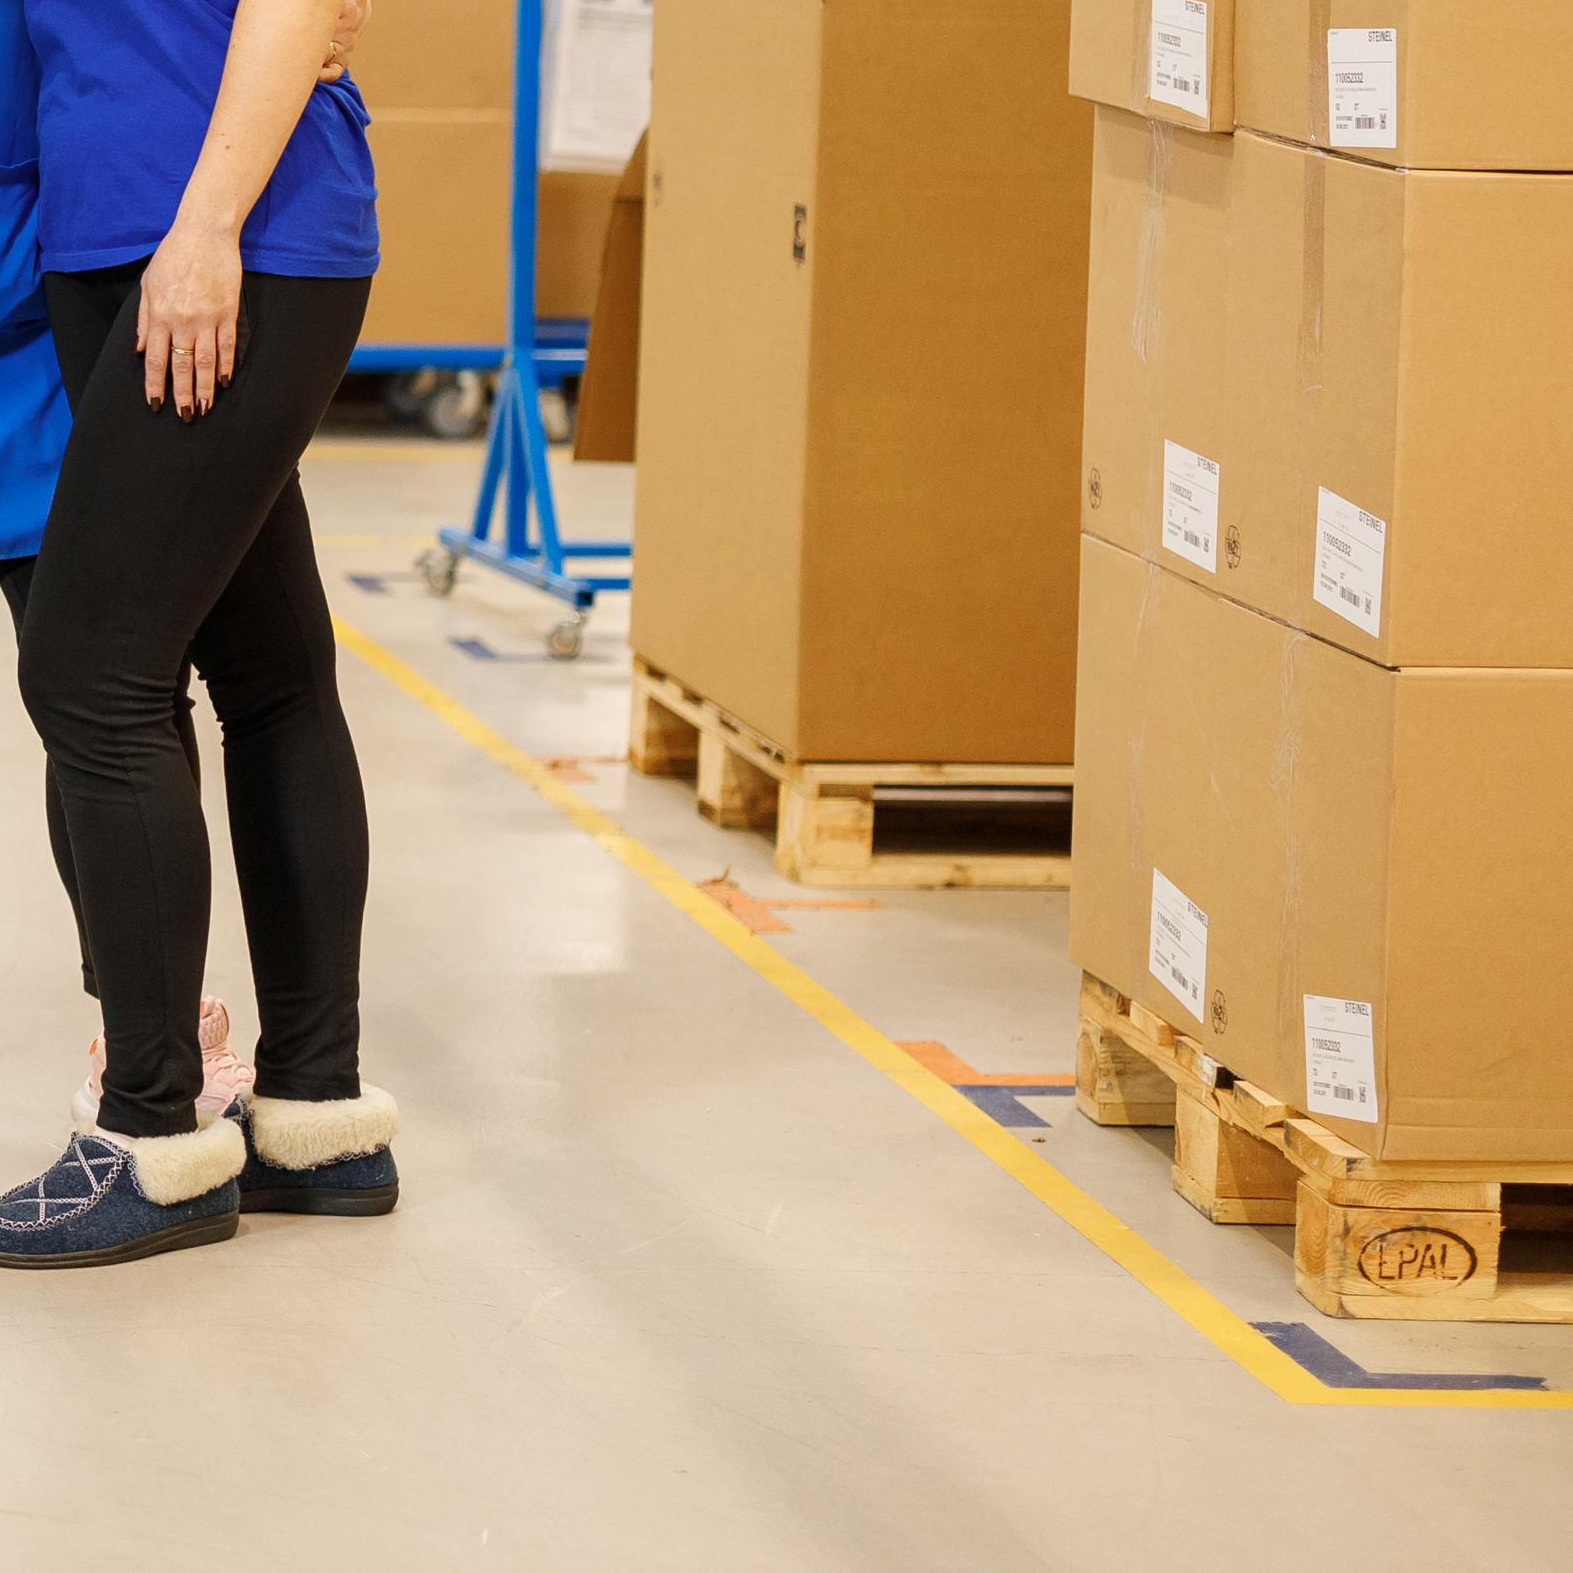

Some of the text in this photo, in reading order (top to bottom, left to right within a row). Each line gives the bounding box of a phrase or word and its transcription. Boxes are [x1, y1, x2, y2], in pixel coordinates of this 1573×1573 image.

[1185, 0, 1205, 15] STEINEL
[1368, 31, 1393, 42] STEINEL
[1196, 456, 1218, 475] STEINEL
[1358, 510, 1383, 534] STEINEL
[1187, 901, 1208, 928] STEINEL
[1345, 1001, 1369, 1016] STEINEL
